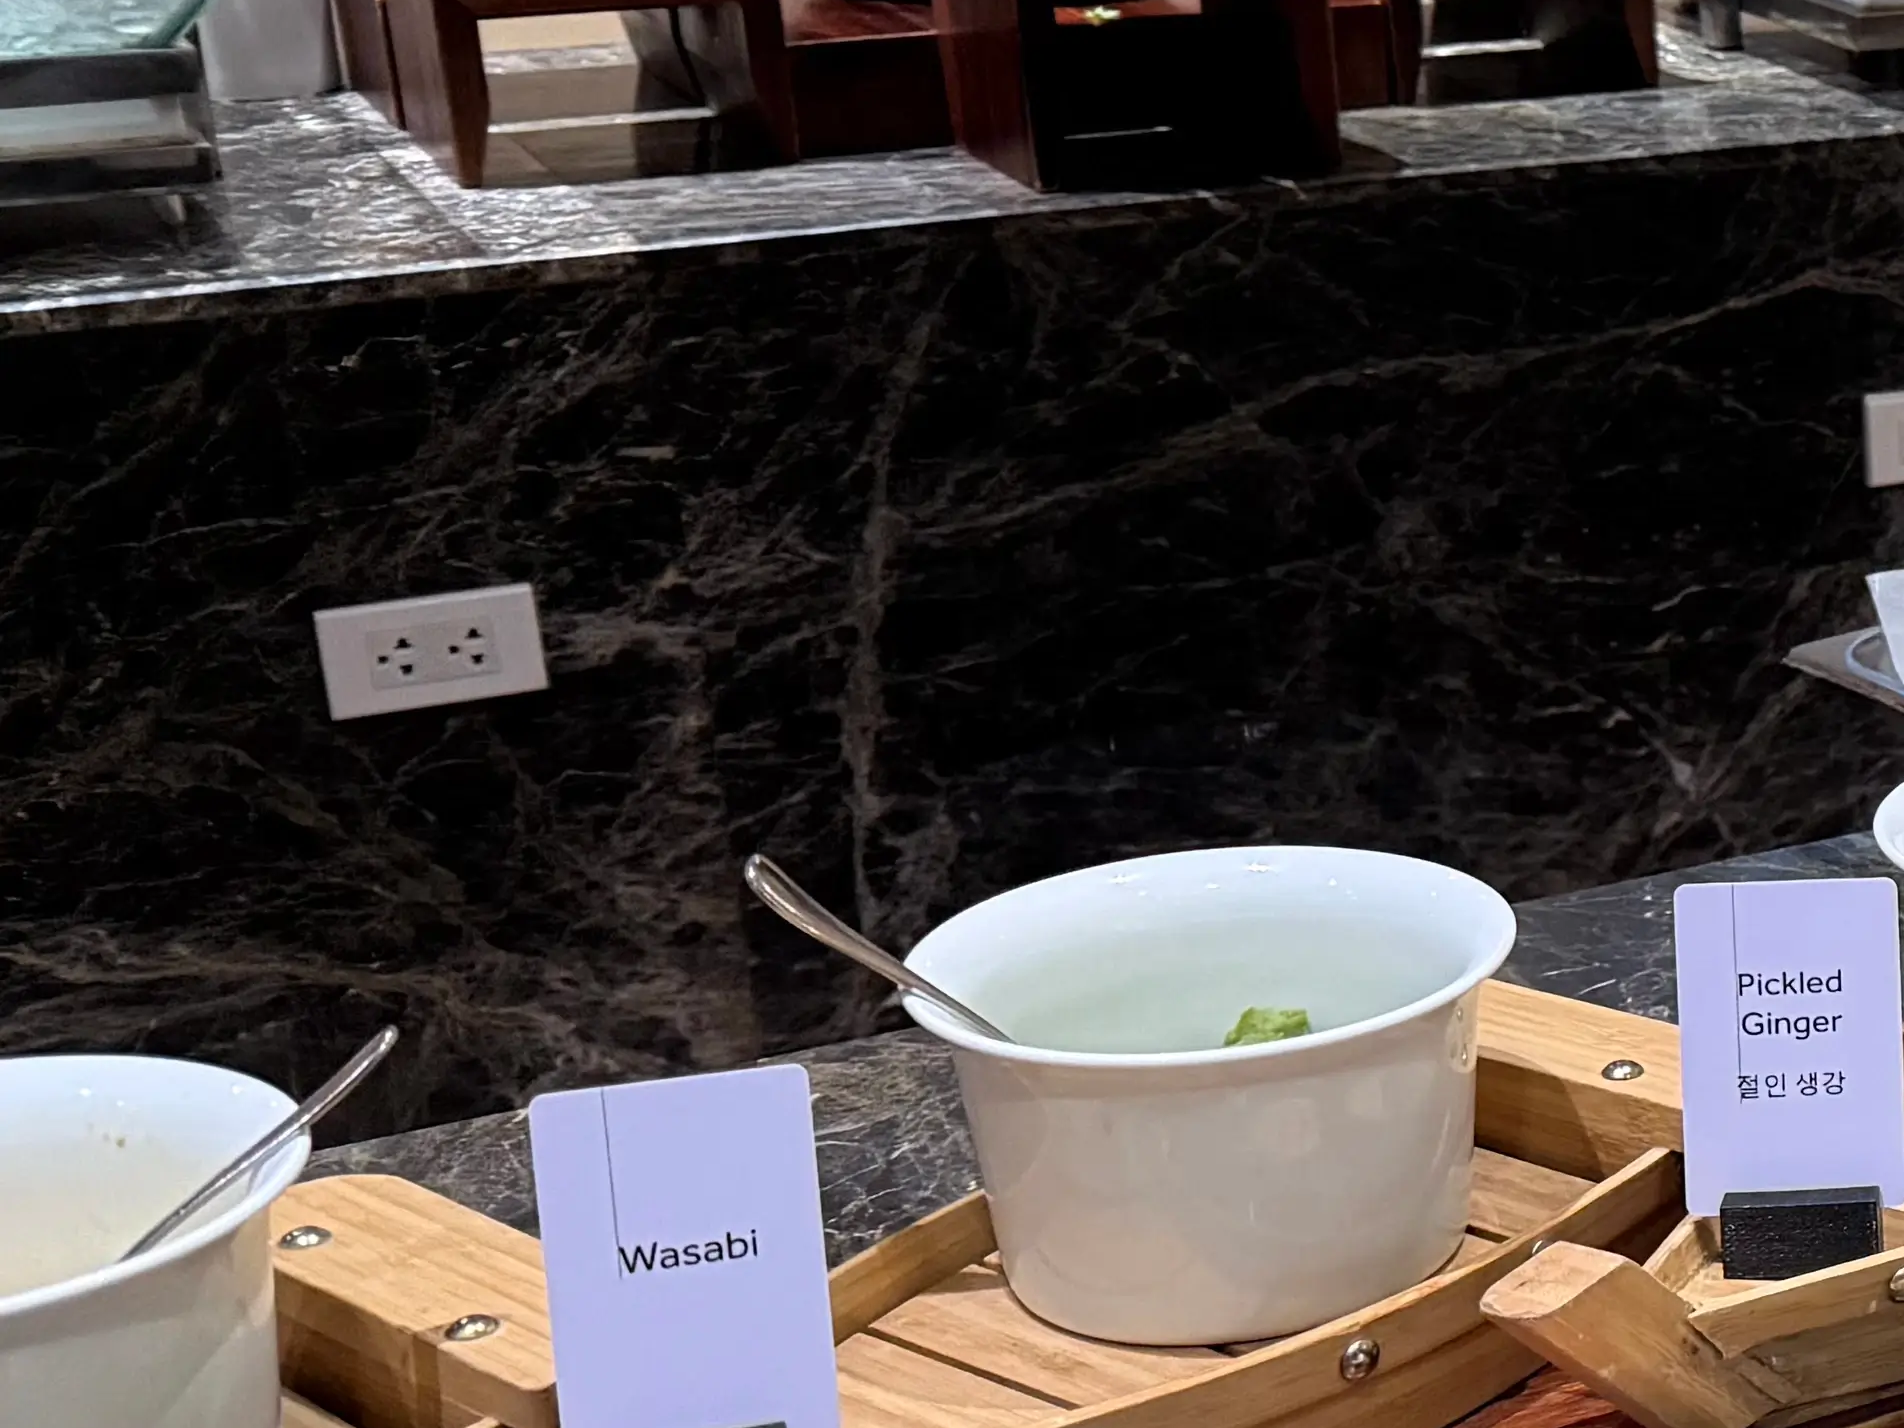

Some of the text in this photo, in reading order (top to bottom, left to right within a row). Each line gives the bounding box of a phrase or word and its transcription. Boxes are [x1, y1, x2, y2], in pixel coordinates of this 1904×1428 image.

[1738, 969, 1843, 997] Pickled
[1741, 1012, 1843, 1040] Ginger
[1737, 1070, 1847, 1100] 절인 생강
[618, 1229, 760, 1274] Wasabi
